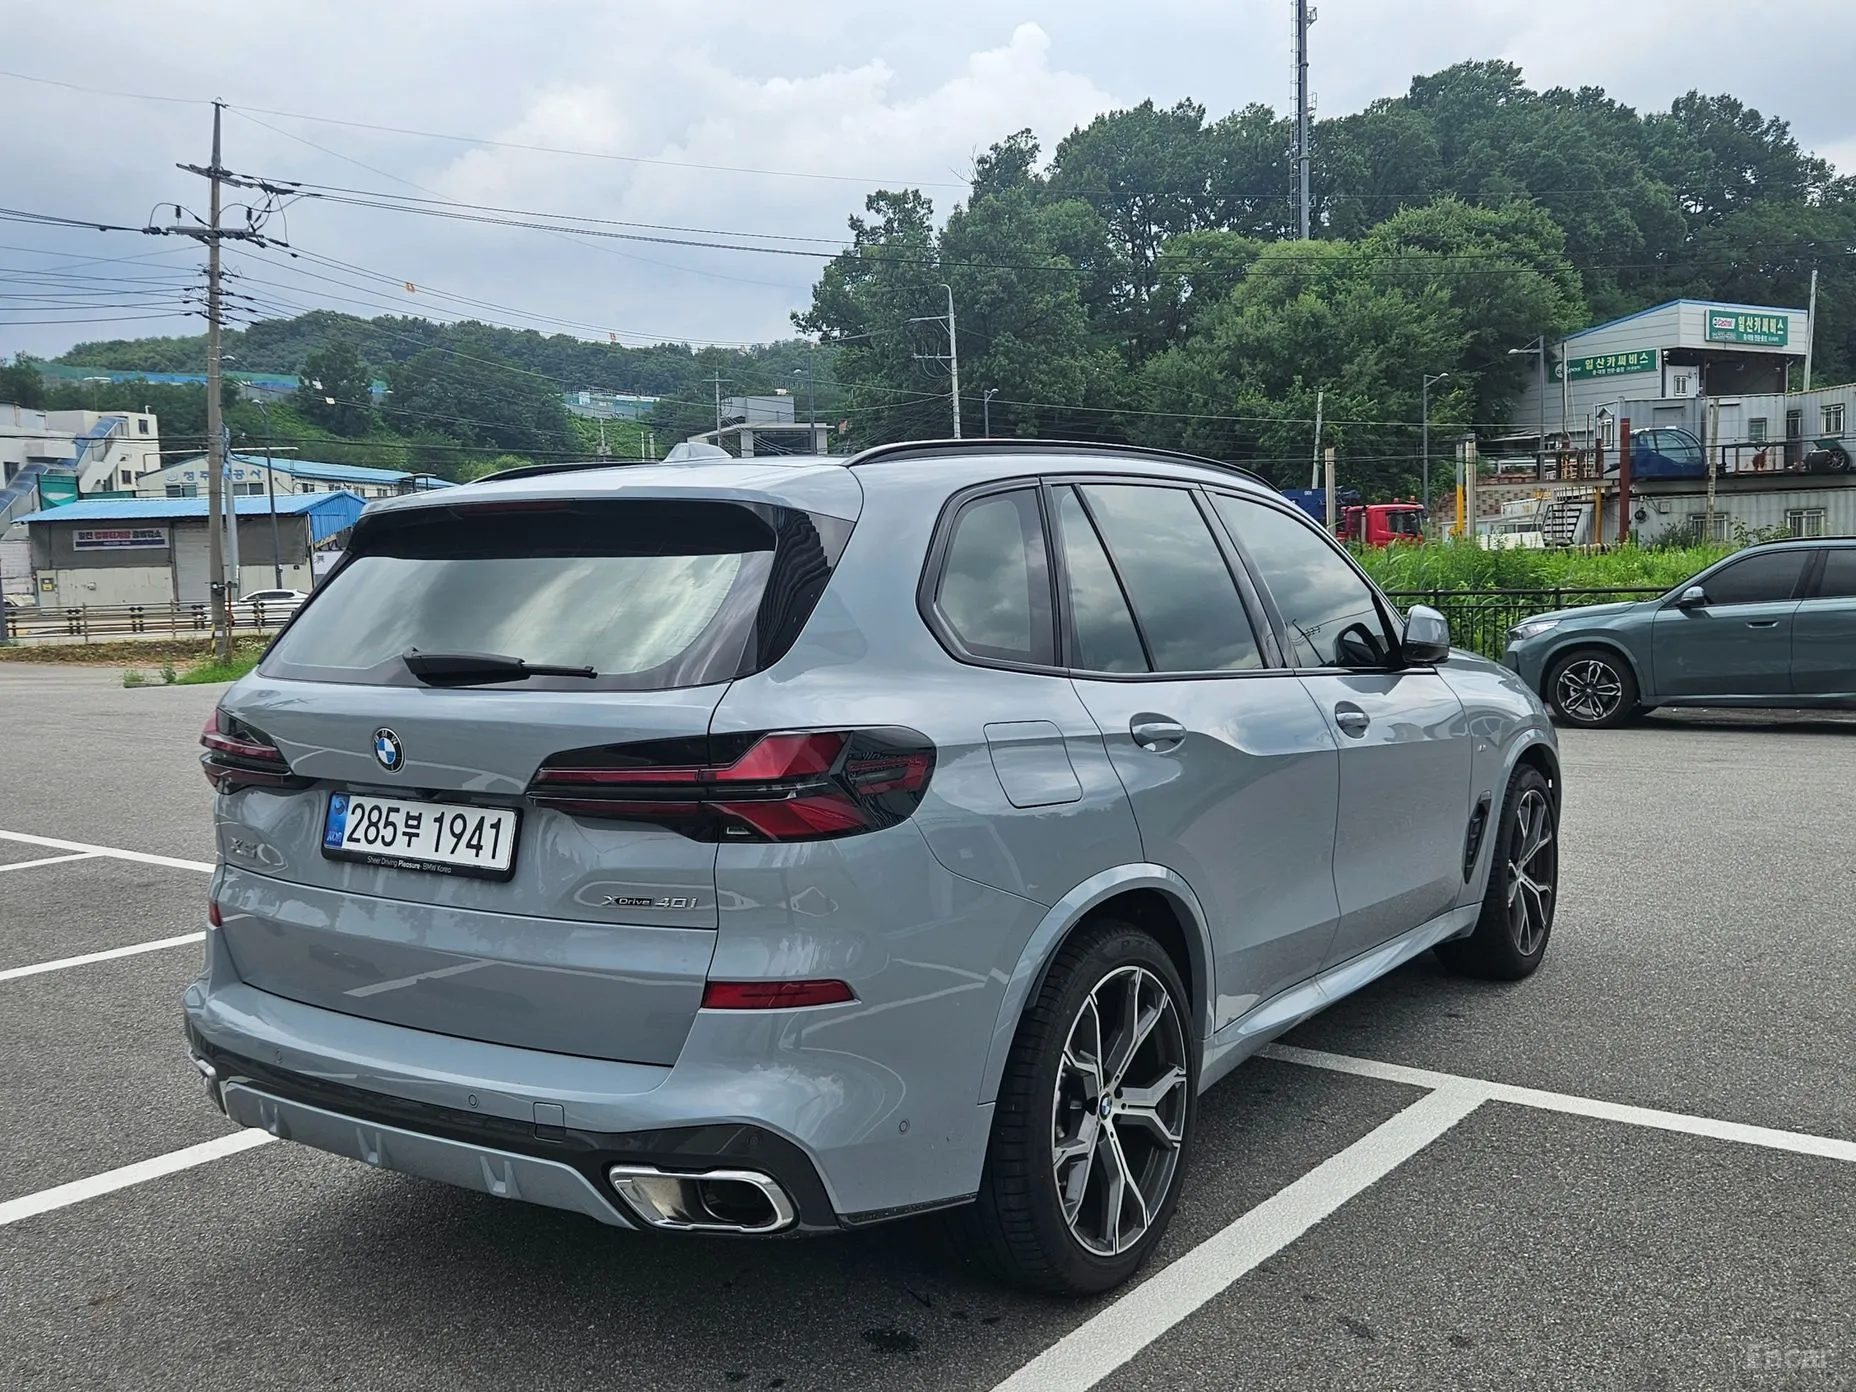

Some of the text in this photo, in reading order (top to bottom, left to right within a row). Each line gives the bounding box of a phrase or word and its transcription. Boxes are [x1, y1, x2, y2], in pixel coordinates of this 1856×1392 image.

[346, 802, 502, 860] 285부 1941
[367, 855, 381, 865] Sheer
[381, 857, 398, 868] Driving
[398, 859, 421, 870] Pleasure
[422, 862, 436, 872] BMW
